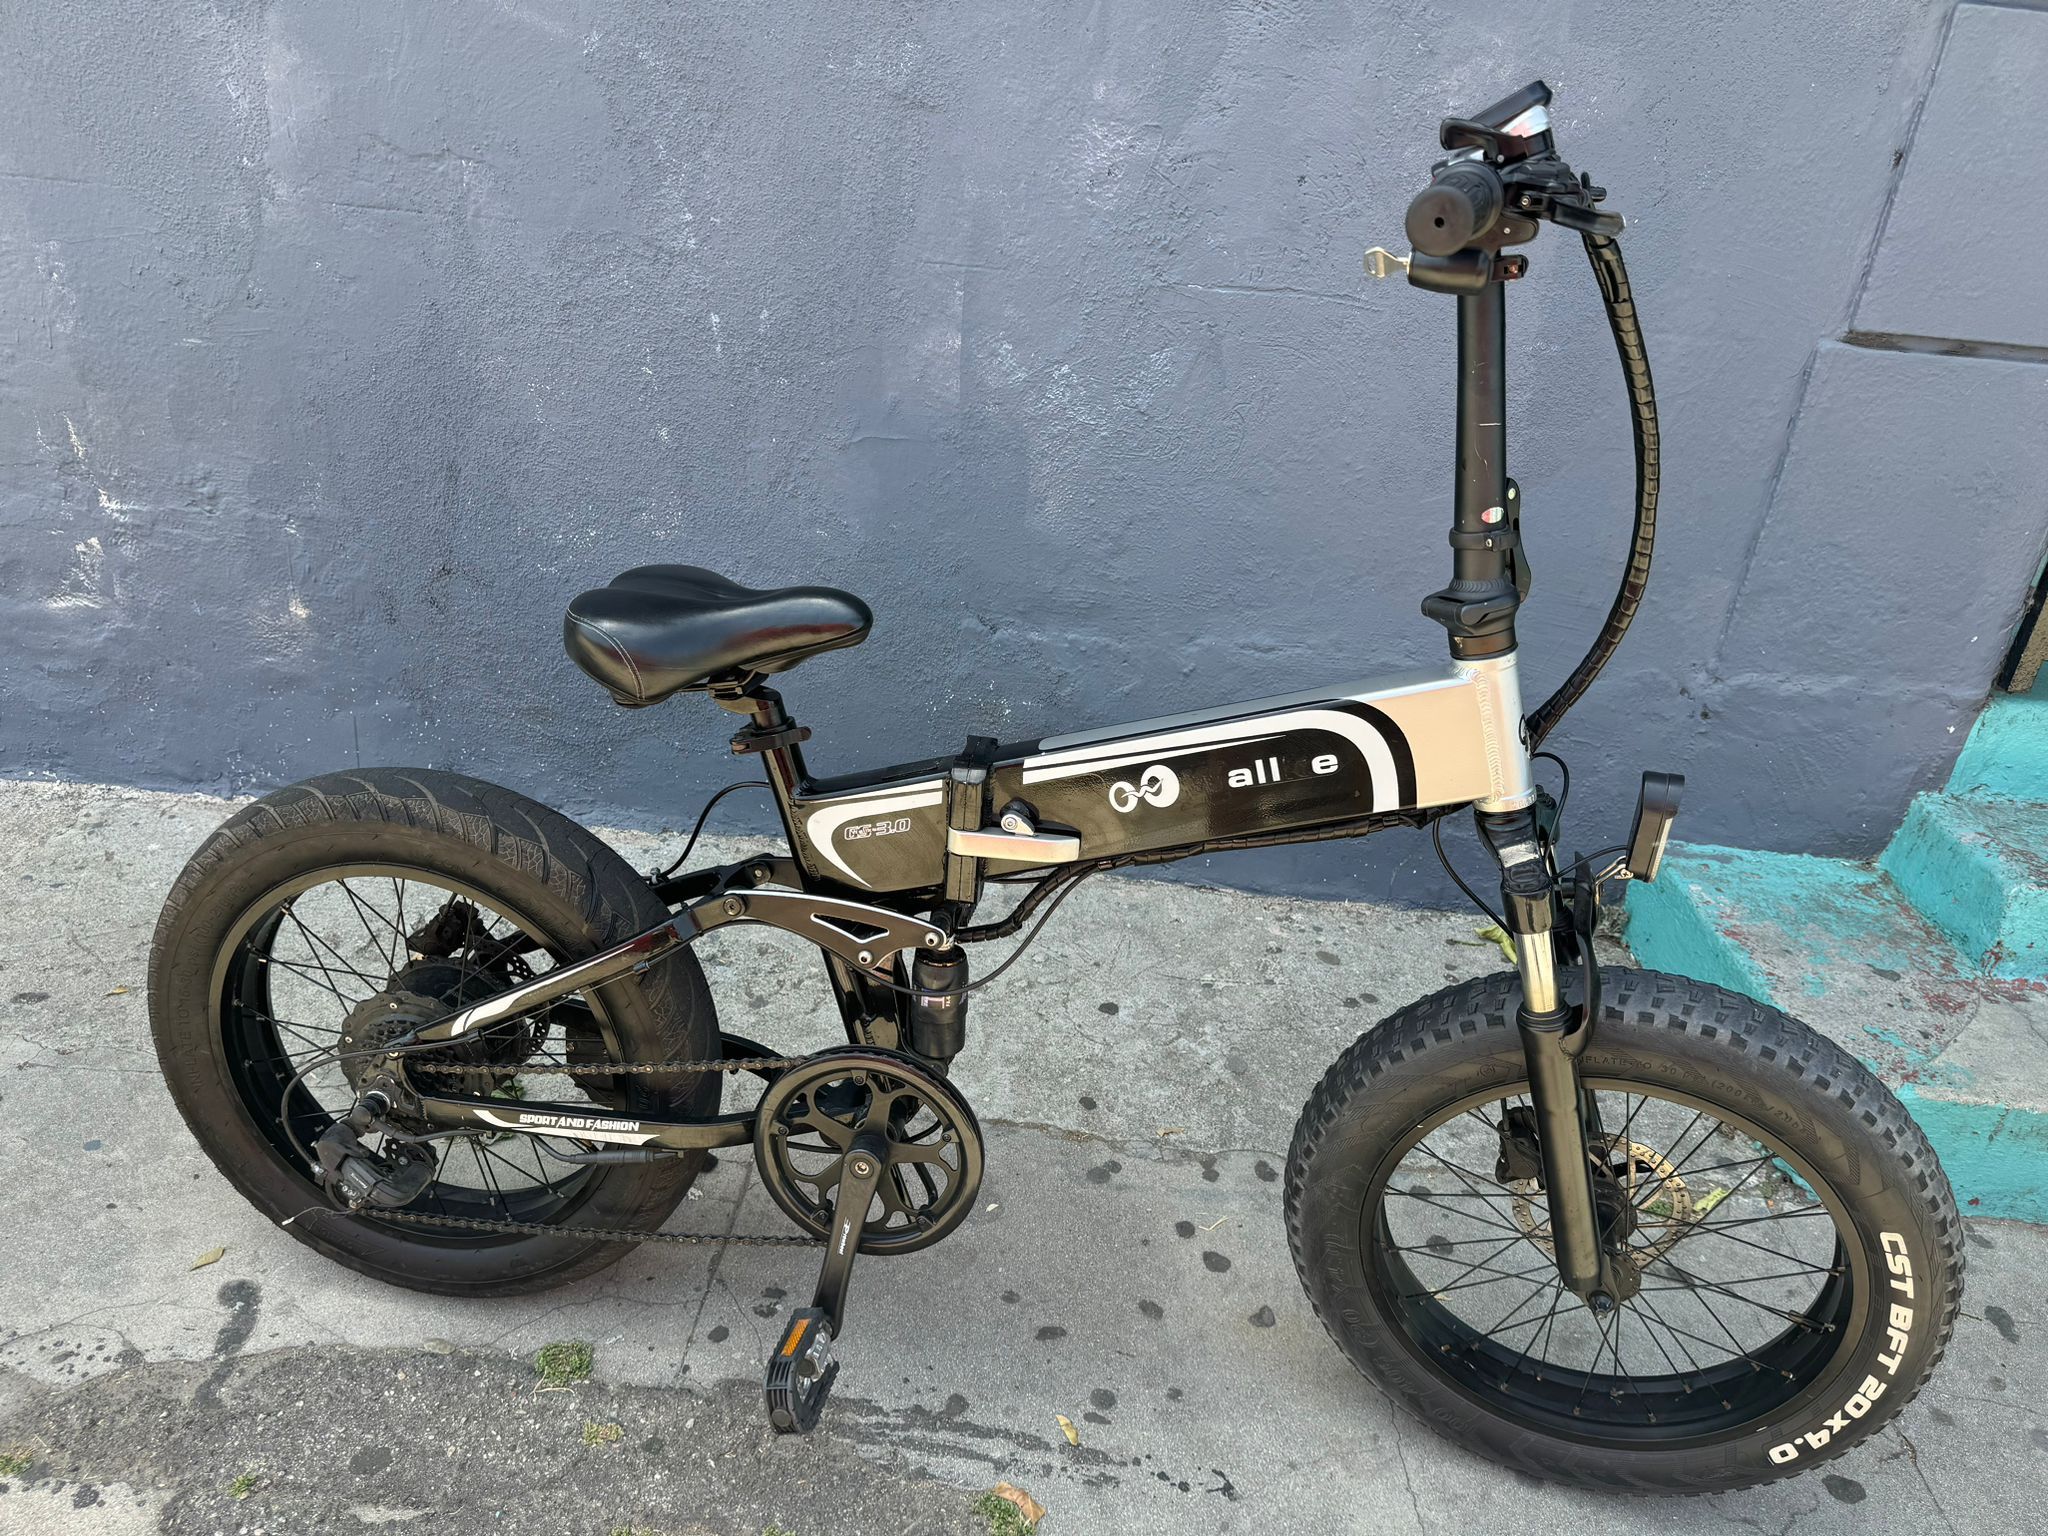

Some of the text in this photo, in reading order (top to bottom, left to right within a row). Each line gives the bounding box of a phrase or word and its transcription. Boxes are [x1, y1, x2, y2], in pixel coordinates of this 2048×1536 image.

[1228, 754, 1339, 788] all e
[519, 1113, 640, 1132] SPORT AND FASHION
[1768, 1231, 1915, 1465] CST BFT 20x4.0
